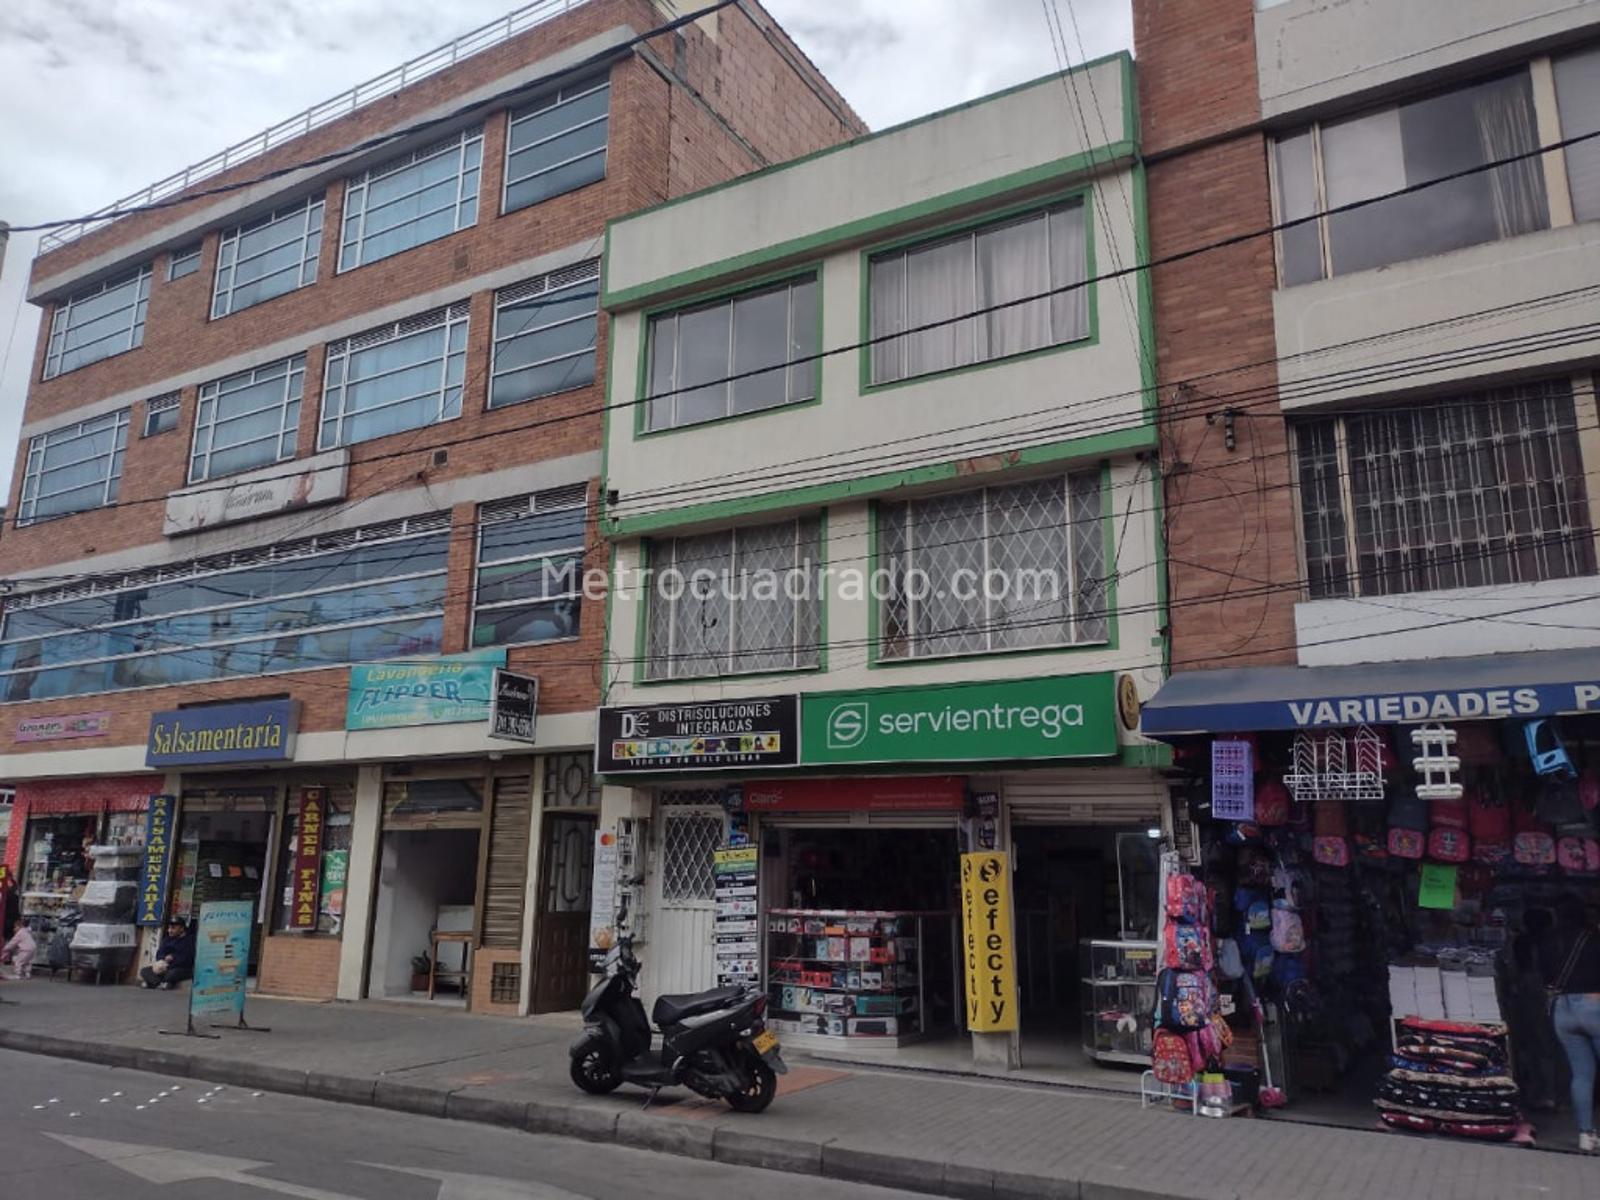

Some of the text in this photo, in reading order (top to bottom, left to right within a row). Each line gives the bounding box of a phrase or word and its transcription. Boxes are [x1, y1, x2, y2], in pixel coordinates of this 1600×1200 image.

[355, 680, 464, 713] FLIPPER
[658, 704, 771, 722] DISTRISOLUCIONES
[1288, 688, 1540, 725] VARIEDADES
[152, 714, 281, 754] Salsamentaría
[676, 719, 753, 735] INTEGRADAS
[879, 703, 1084, 738] servientrega
[297, 789, 319, 925] CARNES FINAS
[965, 888, 978, 1022] efecty
[983, 888, 1005, 1023] efecty
